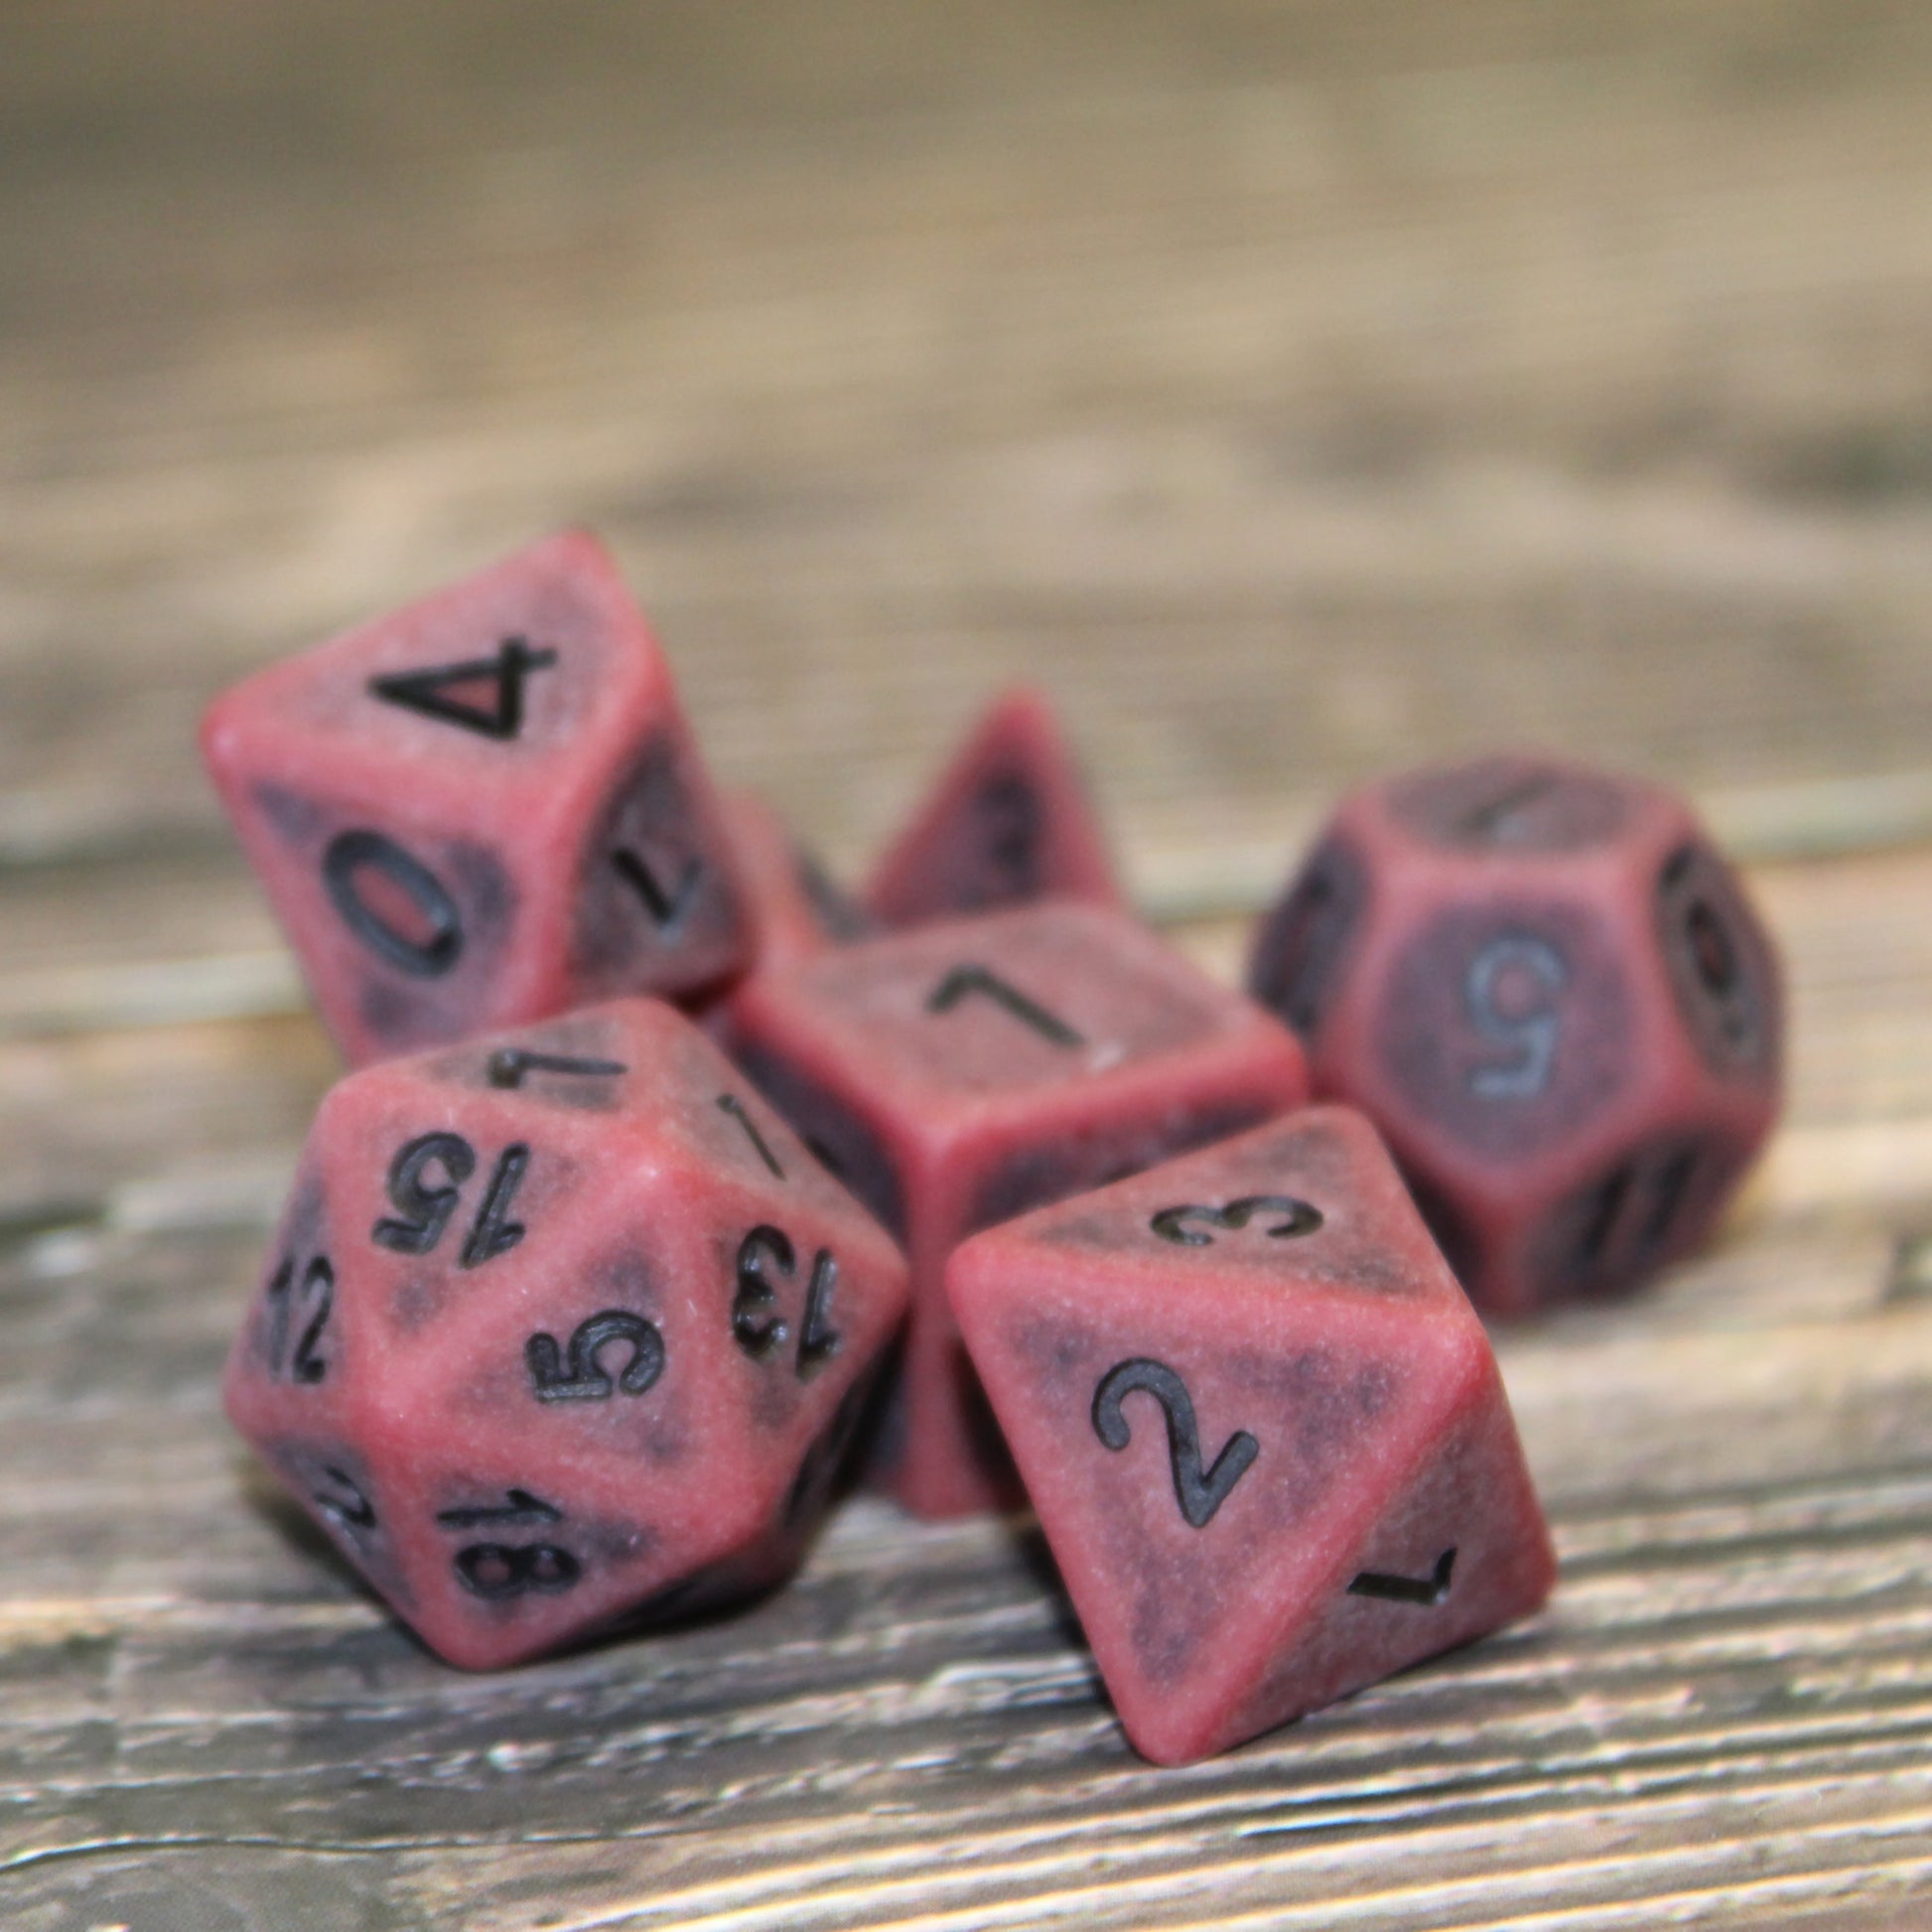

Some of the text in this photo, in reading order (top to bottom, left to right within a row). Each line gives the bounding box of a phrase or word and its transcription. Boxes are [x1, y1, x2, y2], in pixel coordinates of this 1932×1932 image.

[367, 632, 558, 742] 4
[321, 829, 464, 980] 0
[1466, 936, 1569, 1100] 5
[370, 1131, 530, 1270] 15
[1150, 1194, 1324, 1247] 3
[266, 1254, 336, 1384] 12
[525, 1309, 666, 1404] 5
[731, 1224, 840, 1384] 13
[1092, 1356, 1260, 1529] 2
[437, 1489, 582, 1596] 18
